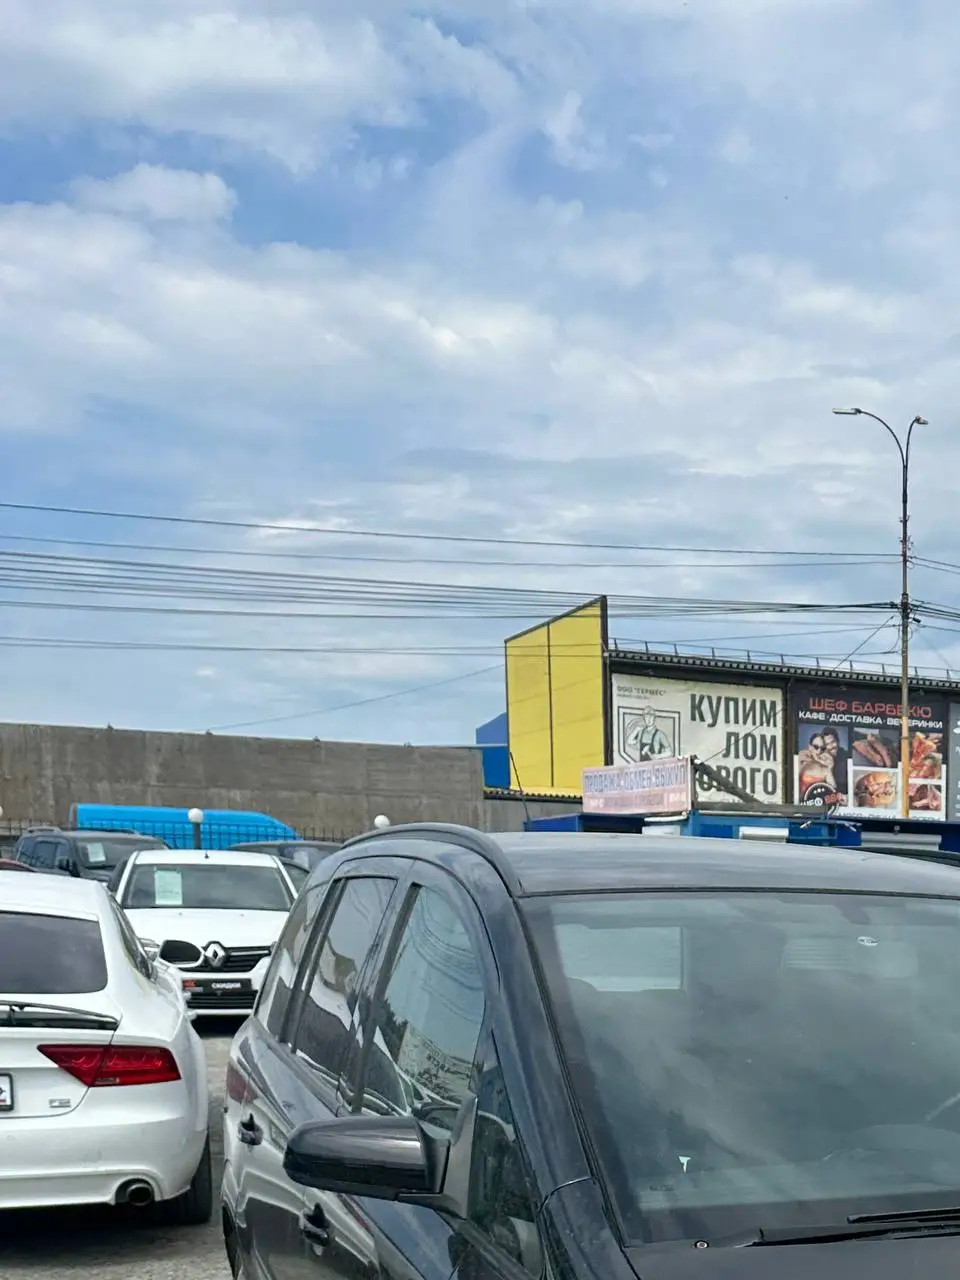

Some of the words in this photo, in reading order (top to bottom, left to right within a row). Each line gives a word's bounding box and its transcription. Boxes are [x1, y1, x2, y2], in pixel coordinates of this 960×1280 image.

[690, 693, 777, 728] КУПИМ
[799, 711, 826, 720] КАФЕ
[829, 713, 883, 724] ДОСТАВКА
[809, 697, 848, 711] ШЕФ
[722, 731, 777, 762] ЛОМ
[698, 764, 777, 796] ОРОГО
